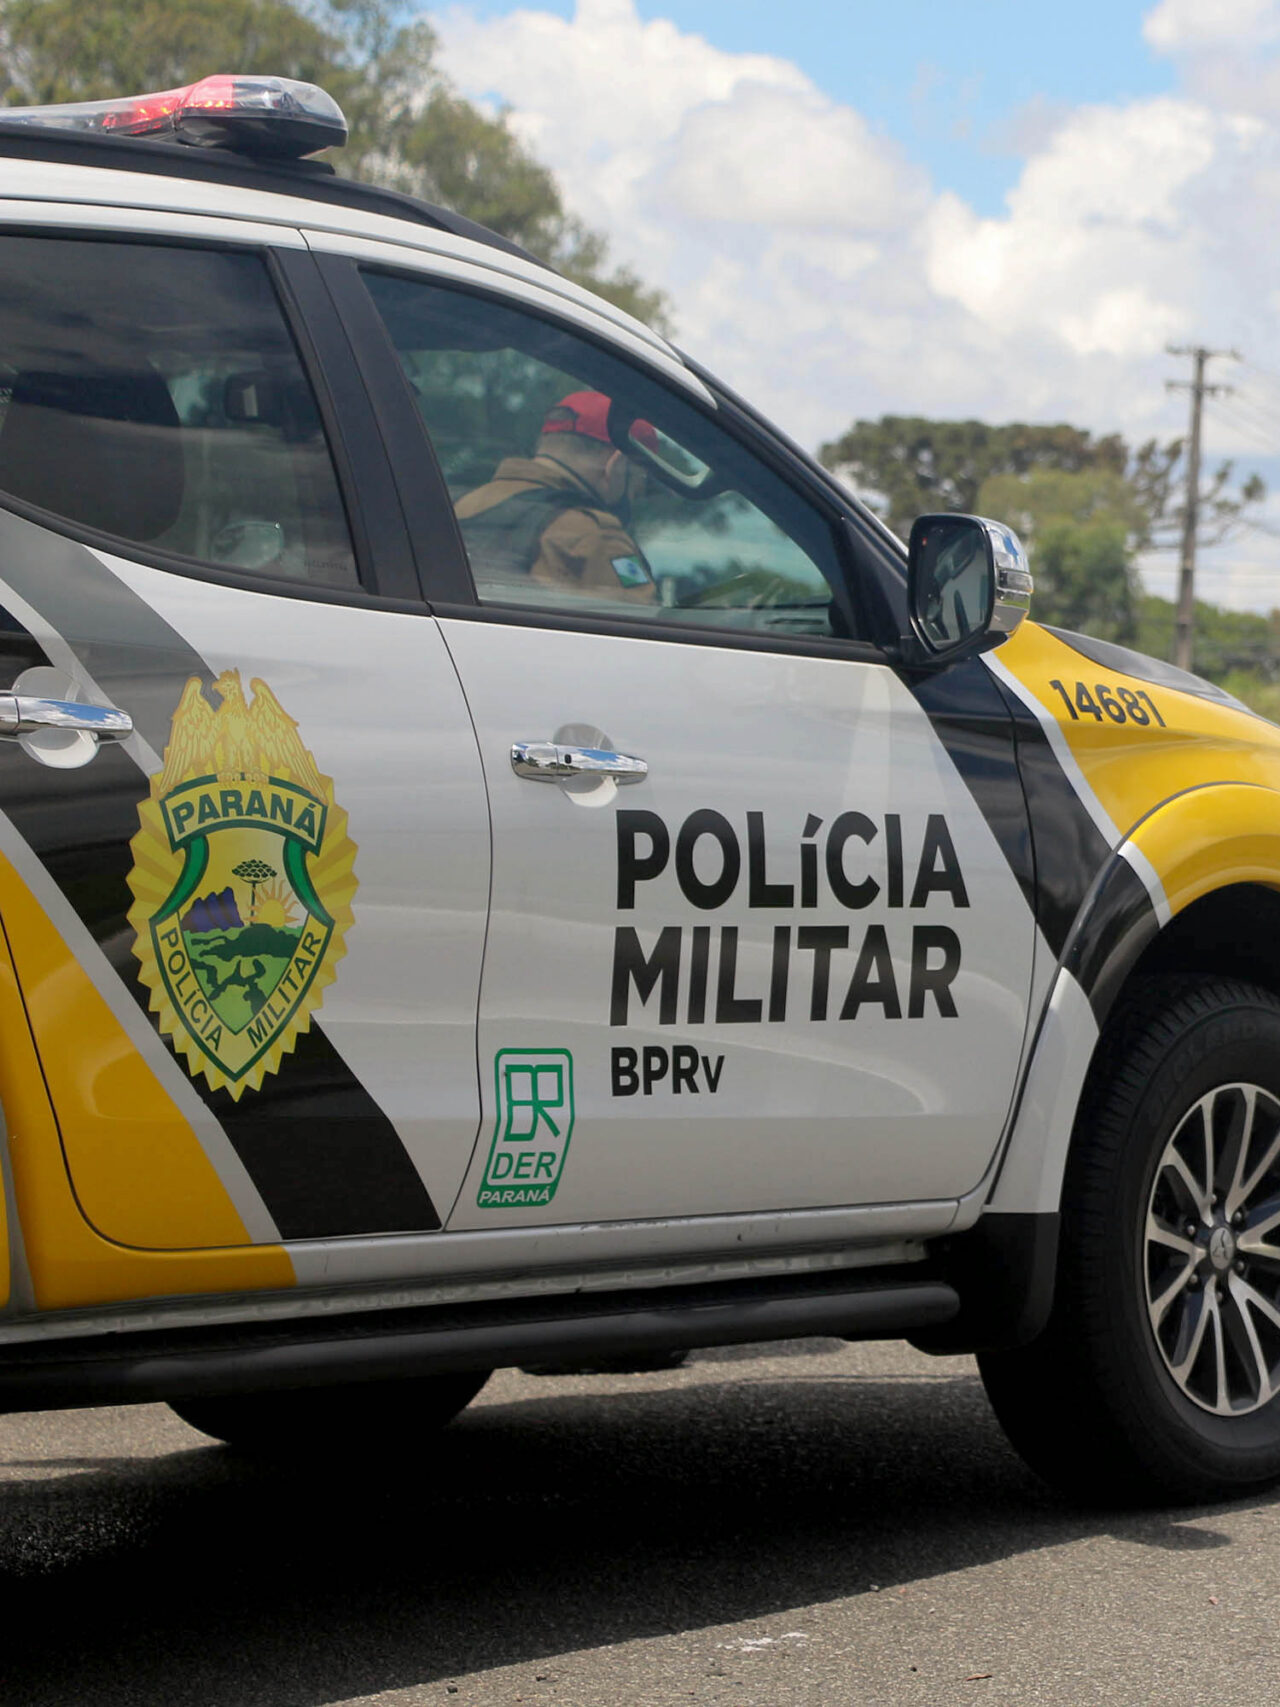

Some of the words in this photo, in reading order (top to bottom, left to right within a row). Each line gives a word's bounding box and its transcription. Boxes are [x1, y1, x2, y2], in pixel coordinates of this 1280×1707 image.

[1049, 679, 1167, 728] 14681
[171, 789, 319, 839] PARANÁ
[616, 808, 970, 910] POLÍCIA
[160, 928, 224, 1052] POLÍCIA
[246, 931, 322, 1049] MILITAR
[610, 924, 962, 1026] MILITAR
[611, 1045, 725, 1096] BPRv
[491, 1152, 557, 1180] DER
[478, 1185, 551, 1204] PARANÁ
